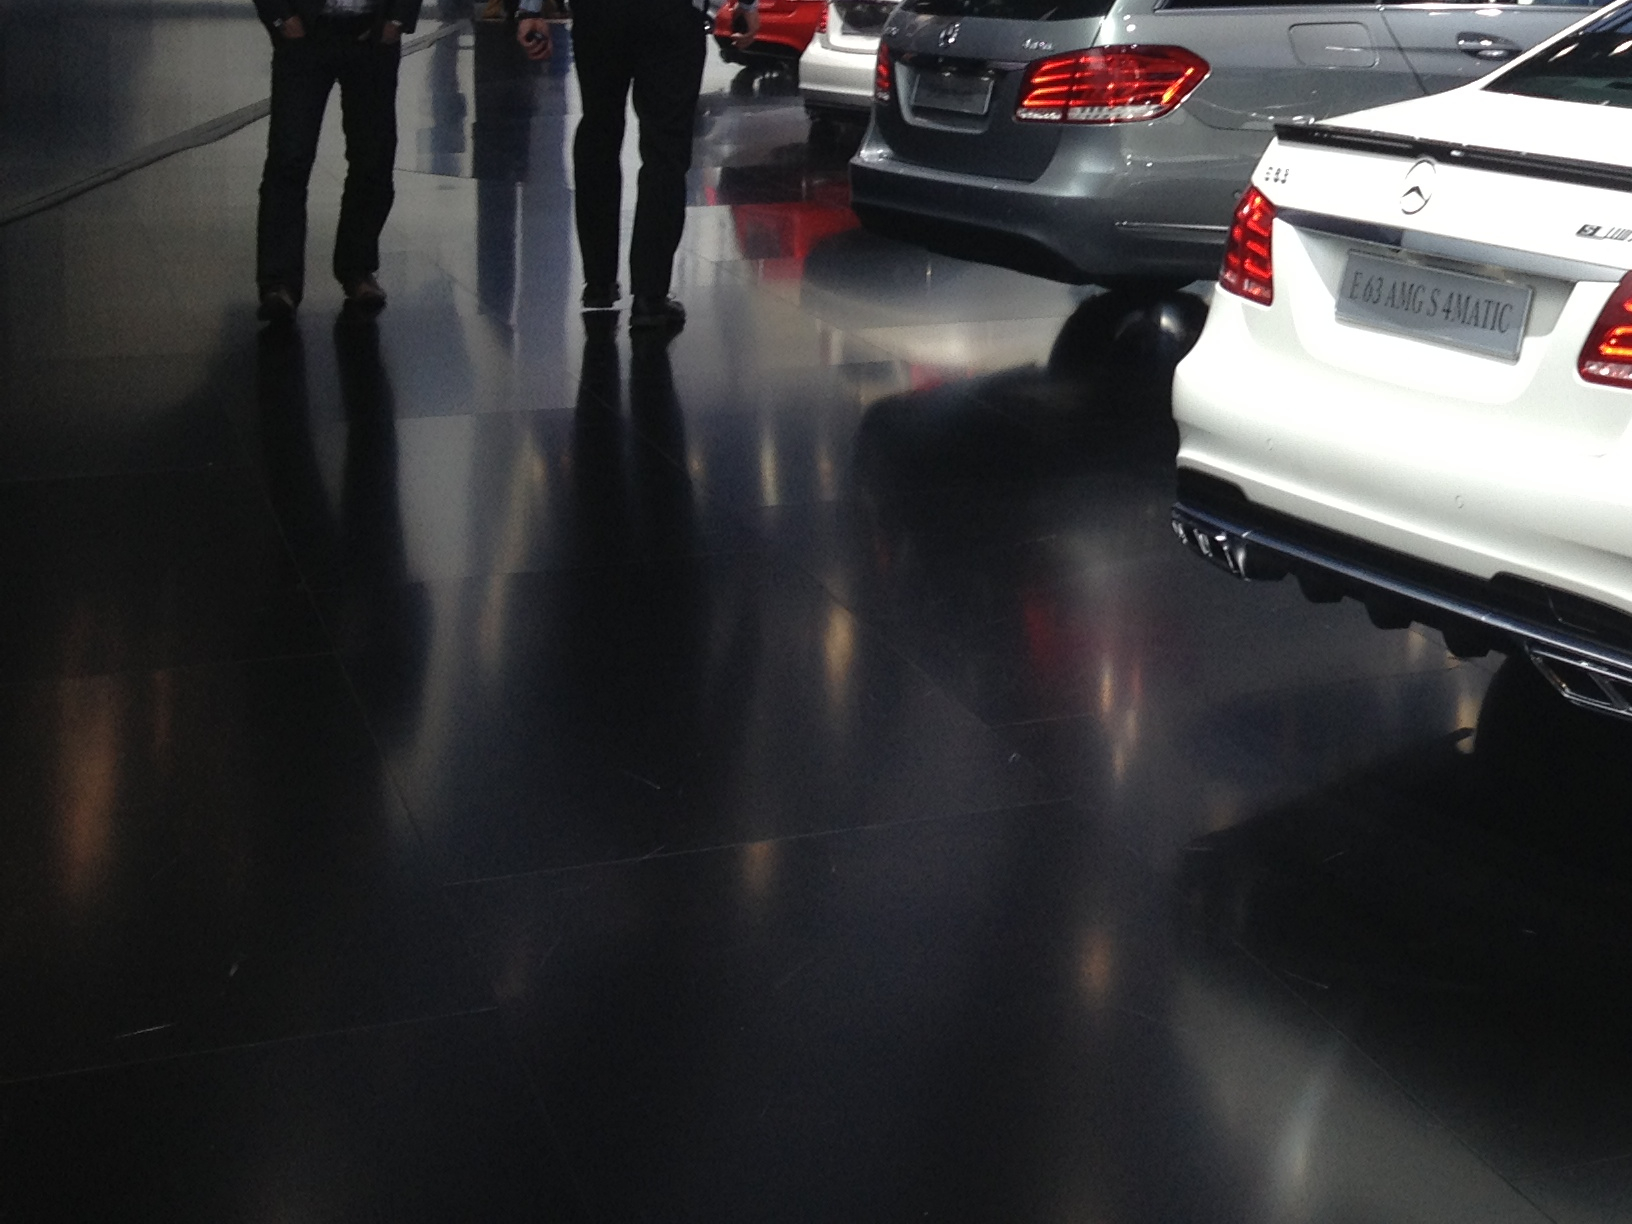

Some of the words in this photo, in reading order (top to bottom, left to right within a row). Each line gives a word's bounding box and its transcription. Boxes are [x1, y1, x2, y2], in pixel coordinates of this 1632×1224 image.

[1348, 271, 1363, 300] E
[1363, 275, 1385, 306] 63
[1384, 284, 1424, 316] AMG
[1427, 291, 1442, 318] S
[1441, 291, 1514, 335] 4MATIC
